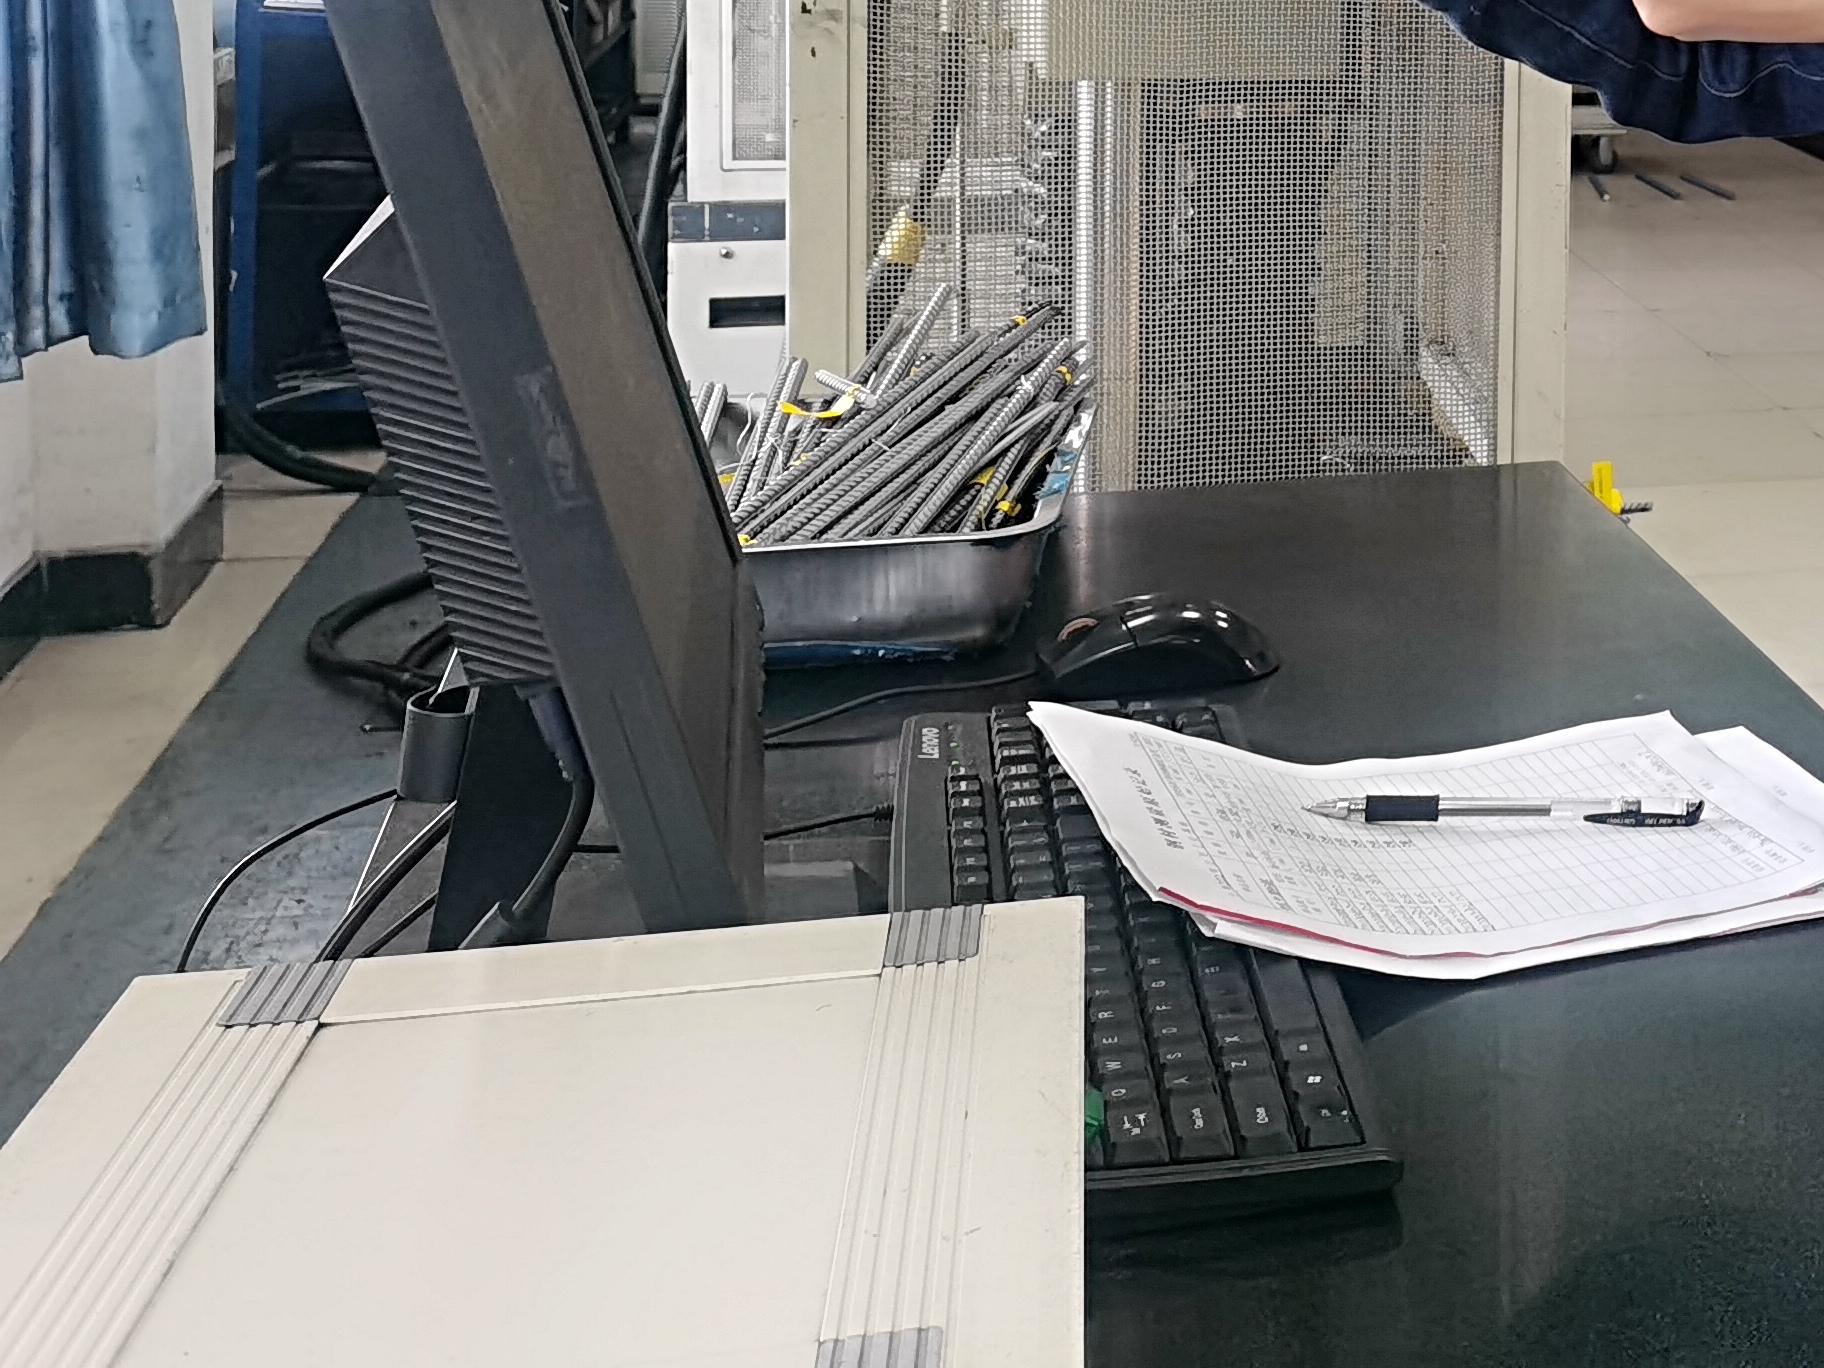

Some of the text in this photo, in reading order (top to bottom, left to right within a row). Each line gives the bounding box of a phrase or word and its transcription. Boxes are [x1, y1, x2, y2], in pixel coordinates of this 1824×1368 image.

[917, 727, 940, 759] Lenovo
[1098, 1010, 1115, 1019] R
[1224, 1035, 1241, 1043] X
[1166, 1052, 1181, 1060] S
[1105, 1061, 1122, 1071] W
